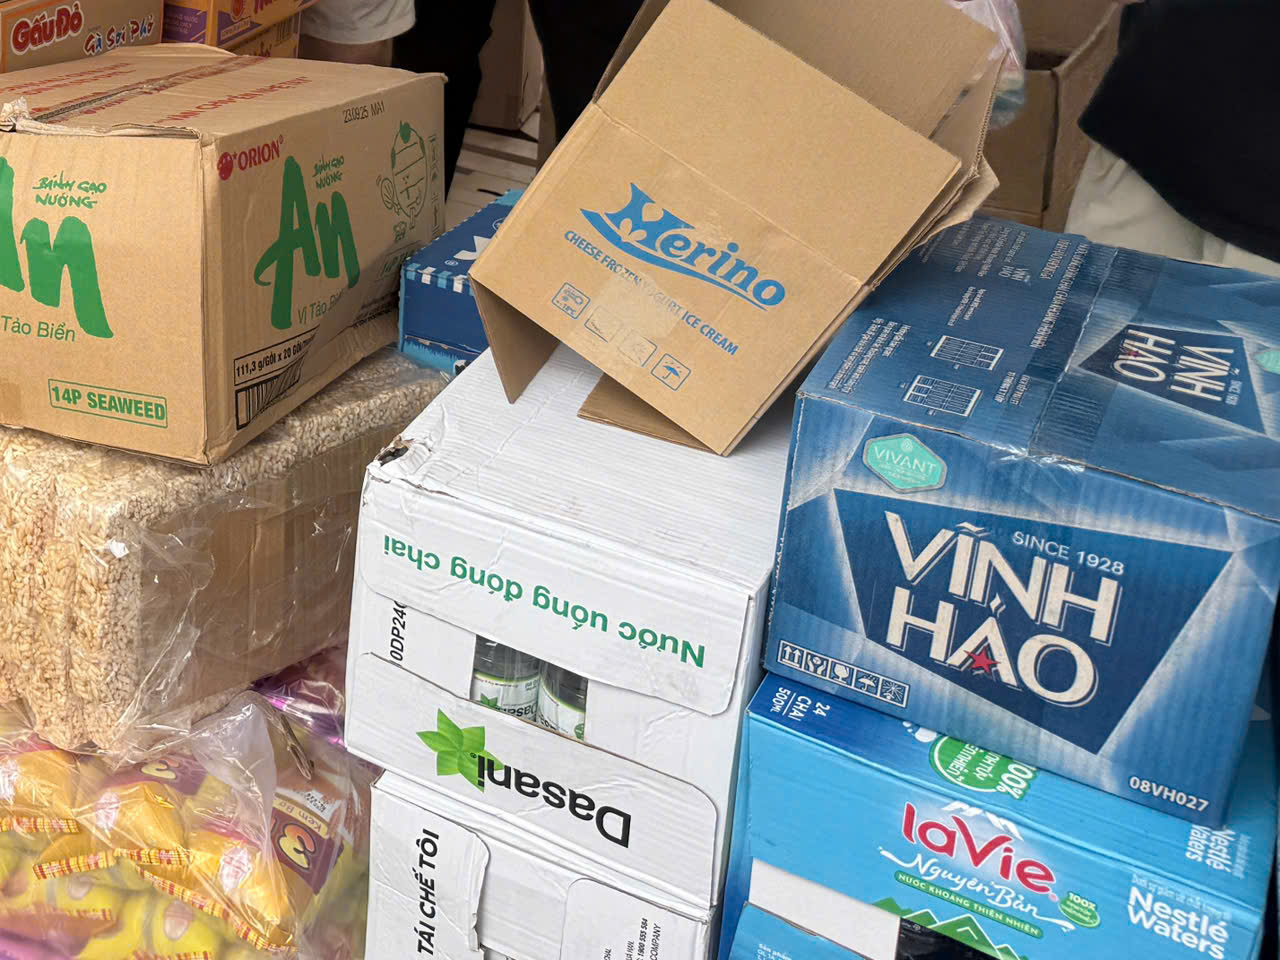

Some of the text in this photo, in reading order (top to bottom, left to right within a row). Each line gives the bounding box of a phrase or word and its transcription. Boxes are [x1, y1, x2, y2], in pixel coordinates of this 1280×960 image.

[237, 143, 282, 173] ORION
[600, 182, 786, 307] Merino
[564, 230, 602, 261] CHEESE
[681, 310, 700, 330] ICE
[699, 323, 740, 356] CREAM
[1, 313, 32, 336] Tảo
[37, 320, 76, 343] Biển
[52, 385, 167, 423] 14P SEAWEED
[874, 445, 937, 473] VIVANT
[884, 510, 1122, 646] VĨNH
[1012, 530, 1125, 577] SINCE 1928
[382, 534, 705, 667] Nước uống đóng chai
[886, 585, 1100, 709] HẢO
[790, 694, 811, 721] CHAI
[814, 701, 830, 718] 24
[477, 754, 632, 849] Dasani
[1129, 774, 1211, 812] 08VH027
[412, 827, 440, 957] TÁI CHẾ TÔI
[1129, 886, 1229, 944] Nestlé
[972, 902, 1004, 922] THIÊN
[1005, 916, 1040, 938] NHIÊN
[1127, 904, 1225, 960] Waters
